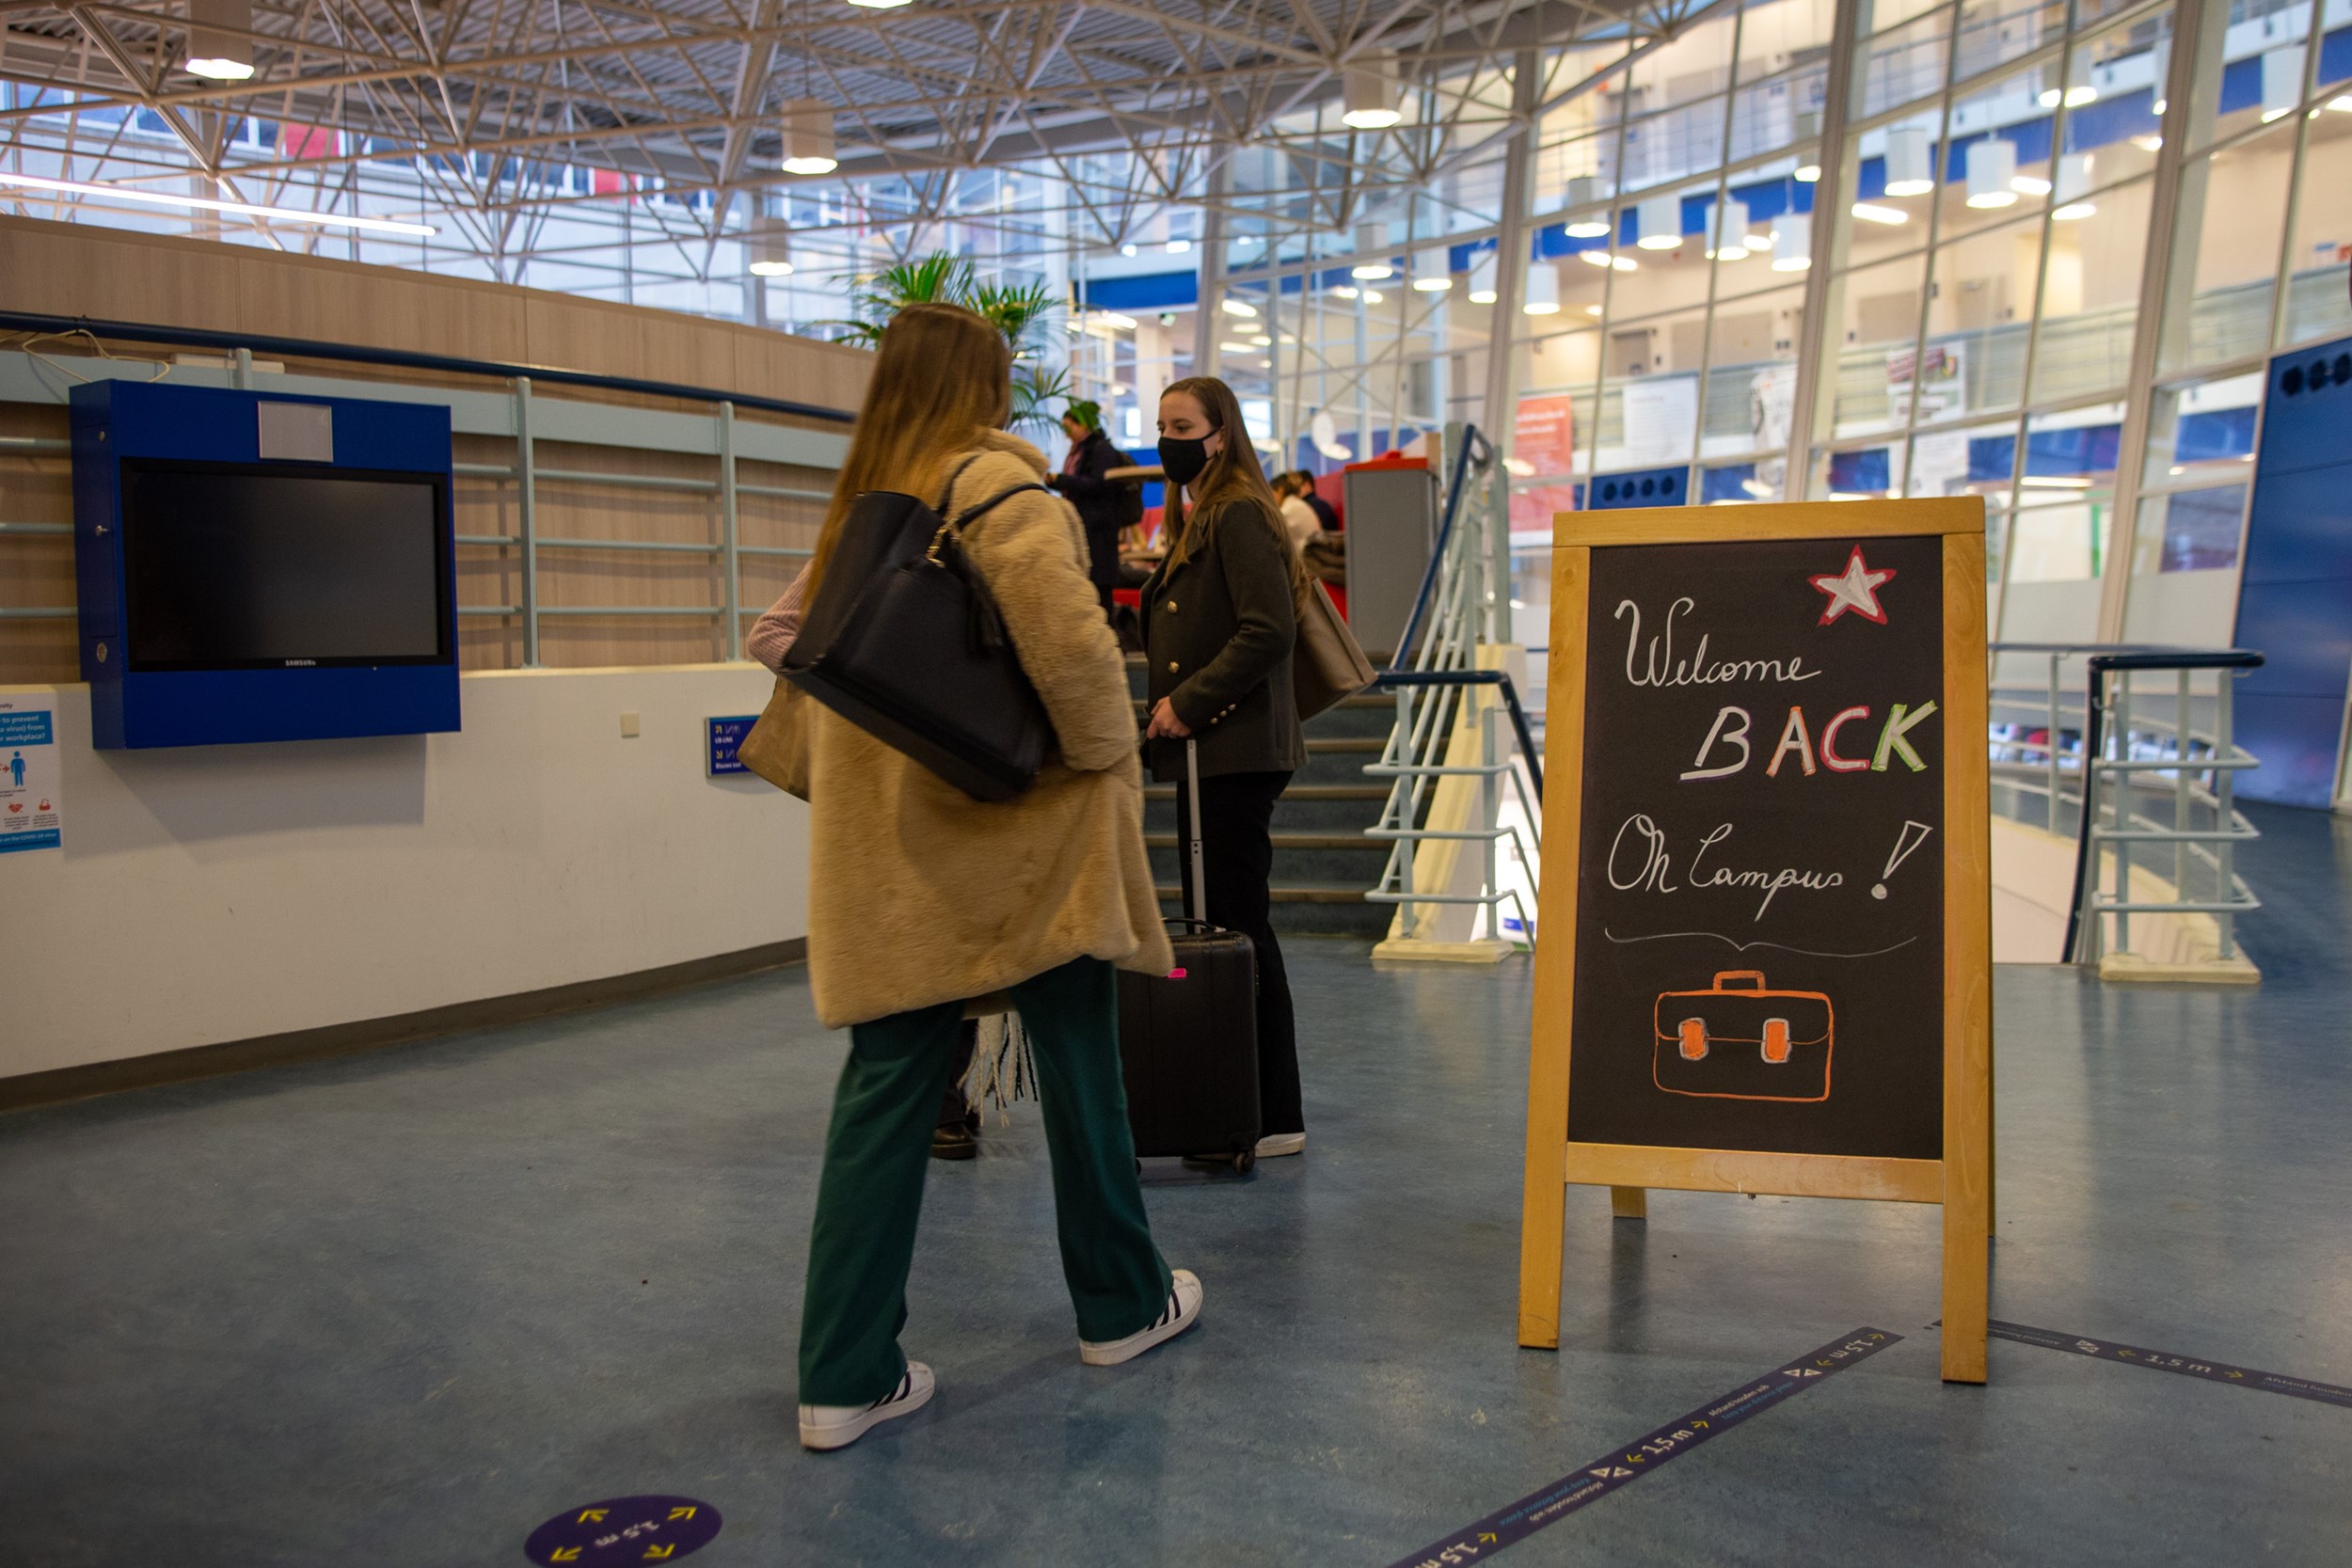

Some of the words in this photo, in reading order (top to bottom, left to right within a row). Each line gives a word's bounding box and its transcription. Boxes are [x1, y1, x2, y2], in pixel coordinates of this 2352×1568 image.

[1613, 596, 1821, 687] Welcome
[1679, 700, 1939, 782] BACK
[1689, 823, 1844, 923] Campus
[2187, 1363, 2212, 1373] m
[1642, 1437, 1675, 1454] 1,5
[1671, 1430, 1693, 1441] m
[1440, 1542, 1478, 1564] 1,5
